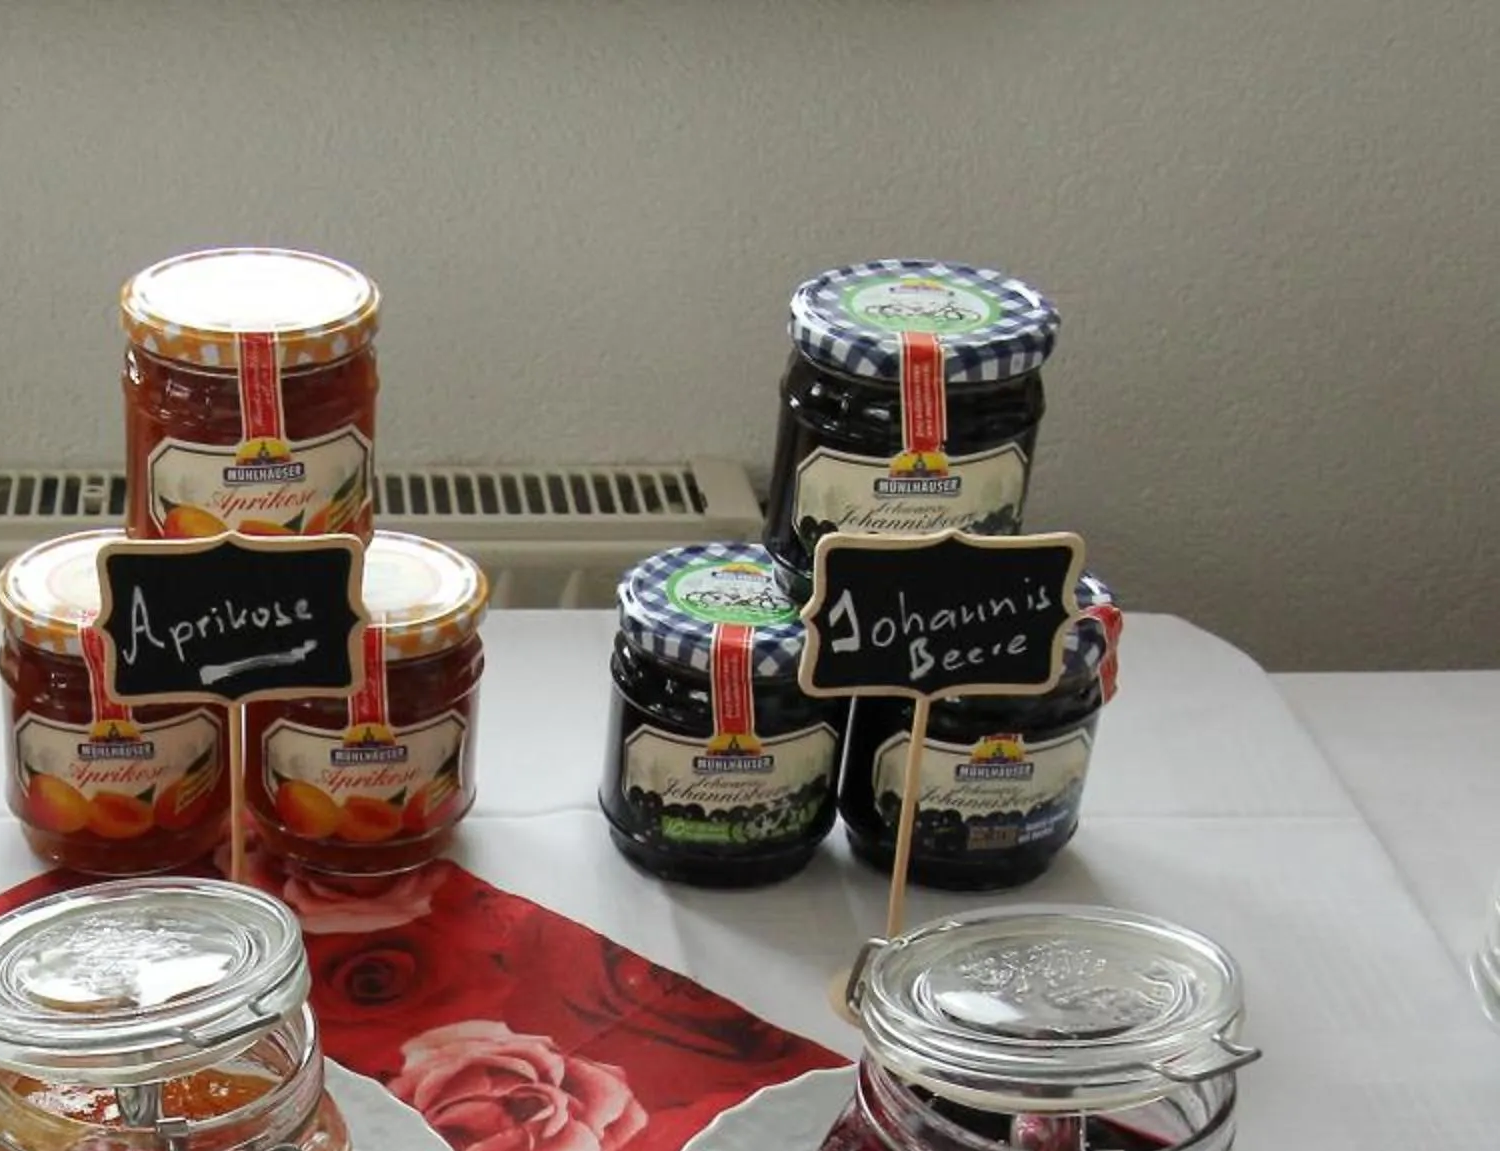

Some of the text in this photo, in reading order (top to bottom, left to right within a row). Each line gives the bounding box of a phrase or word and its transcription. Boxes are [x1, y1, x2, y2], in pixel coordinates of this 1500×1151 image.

[122, 585, 314, 666] Aprikose
[828, 577, 1052, 654] Johannis
[909, 635, 1028, 681] Beere
